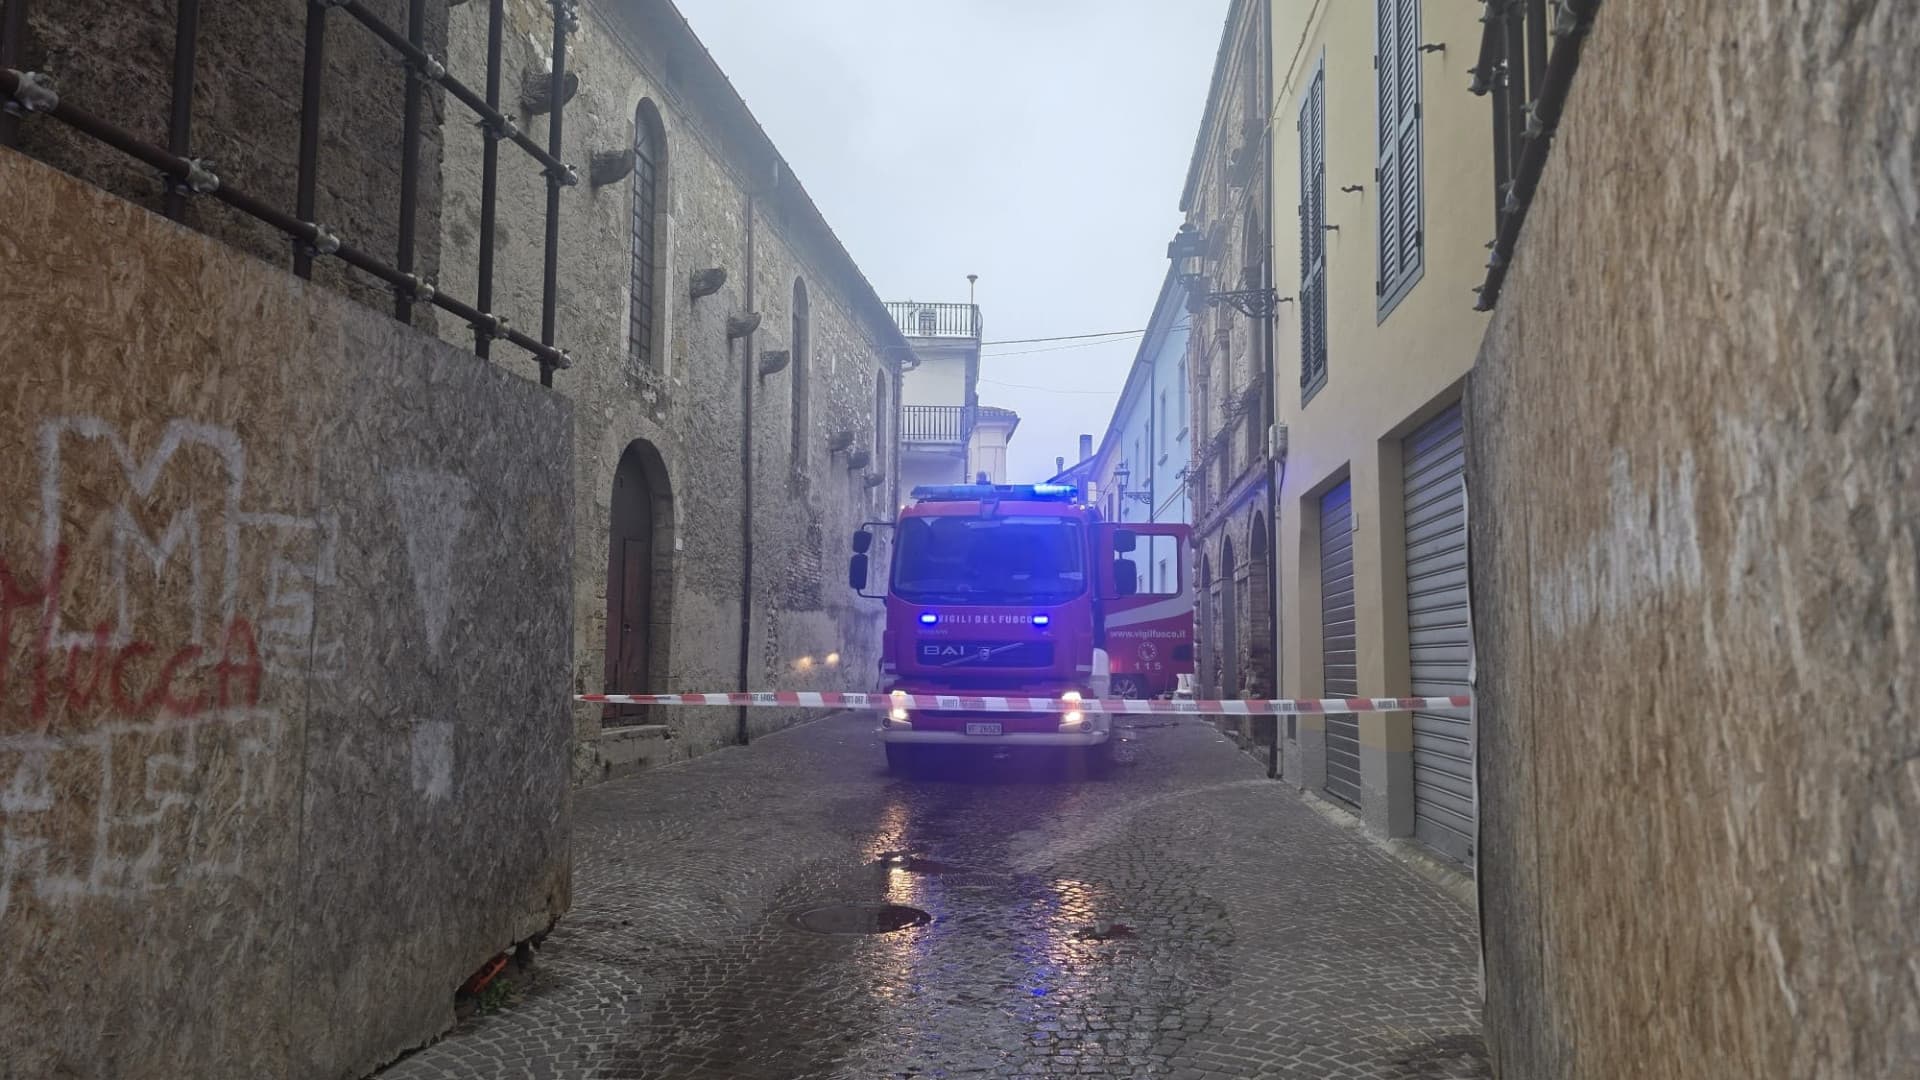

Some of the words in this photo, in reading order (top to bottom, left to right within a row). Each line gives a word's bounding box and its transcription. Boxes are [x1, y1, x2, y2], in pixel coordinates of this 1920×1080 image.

[938, 614, 972, 624] VIGILI
[974, 615, 997, 624] DEL
[999, 615, 1033, 624] FUOCO
[923, 645, 965, 656] BAI
